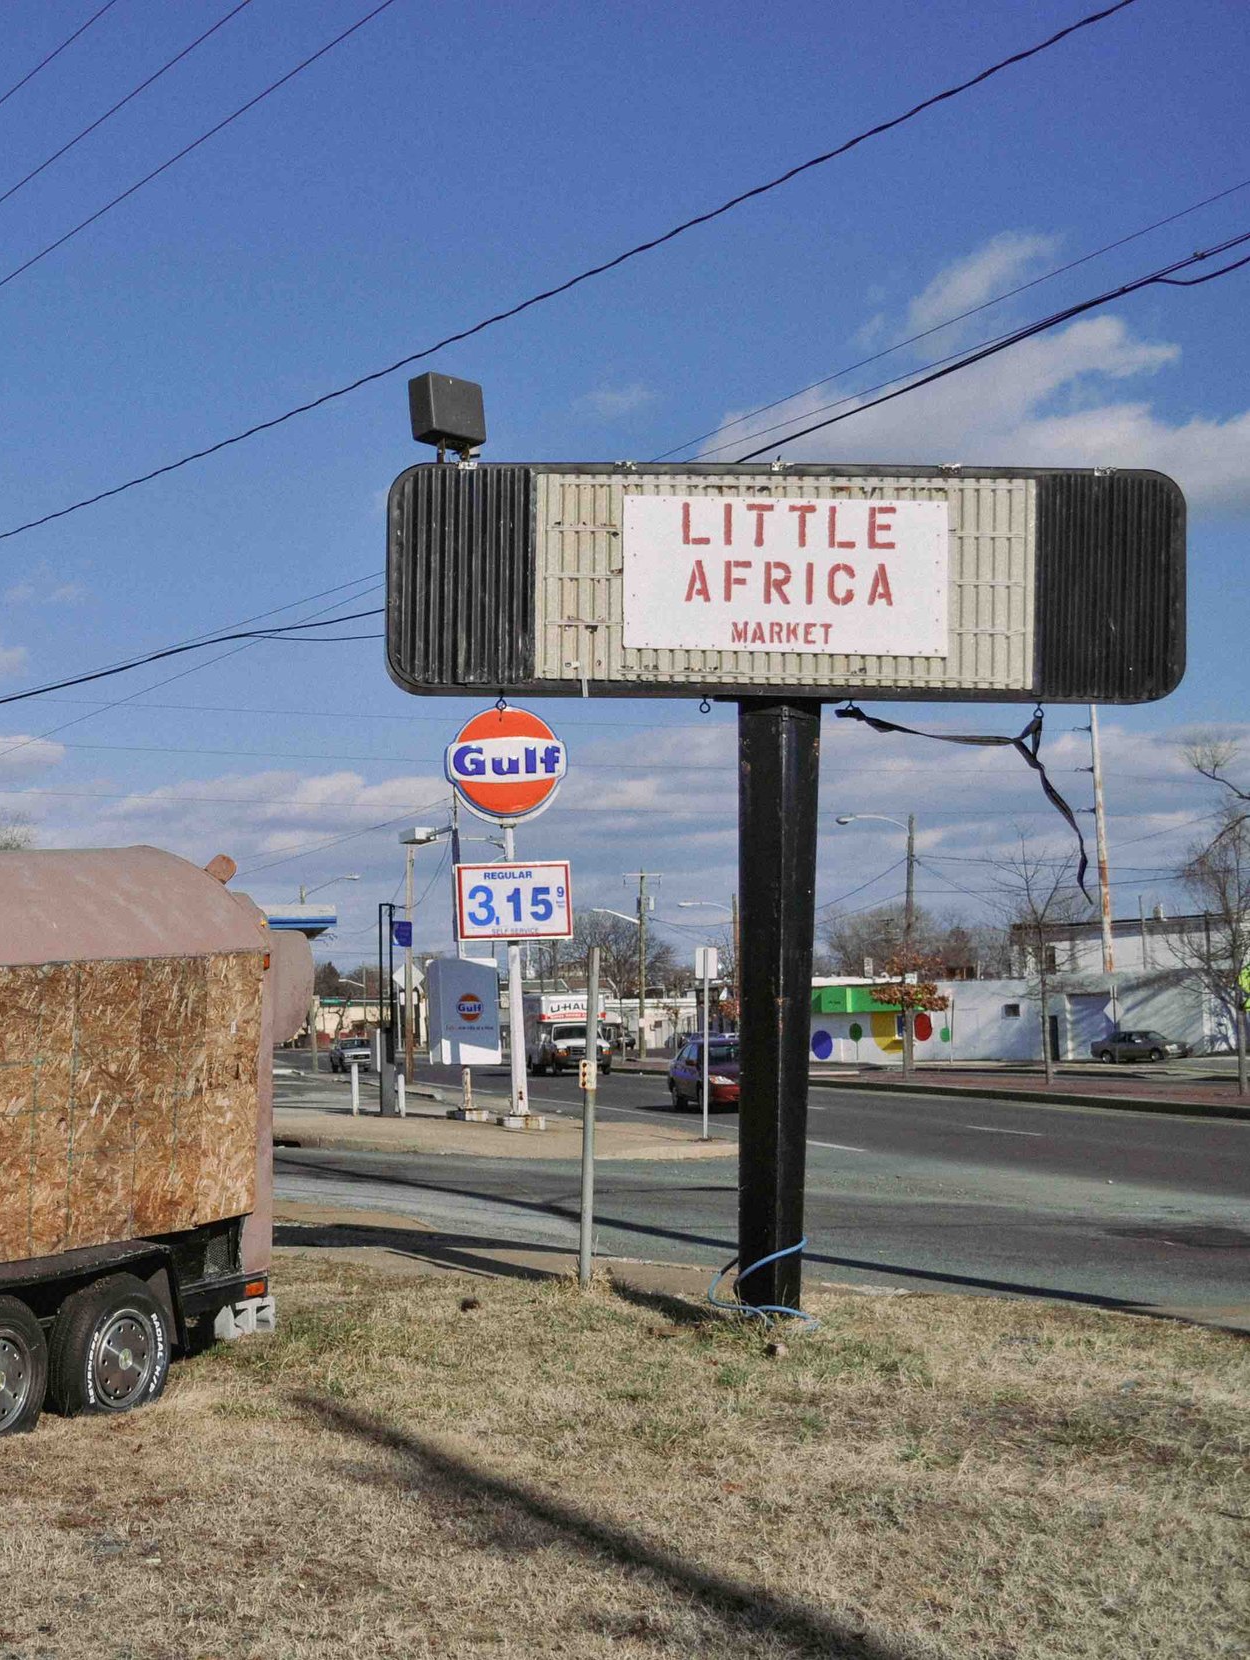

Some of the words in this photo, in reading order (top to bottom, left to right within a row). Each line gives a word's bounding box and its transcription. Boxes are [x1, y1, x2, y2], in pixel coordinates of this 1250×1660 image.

[681, 501, 897, 550] LITTLE
[684, 559, 894, 607] AFRICA
[731, 620, 833, 645] MARKET
[452, 744, 561, 776] Gulf
[483, 870, 533, 880] REGULAR
[491, 927, 509, 935] SELF
[510, 927, 539, 935] SERVICE
[457, 1003, 482, 1012] Gulf
[150, 1312, 164, 1360] RADIAL
